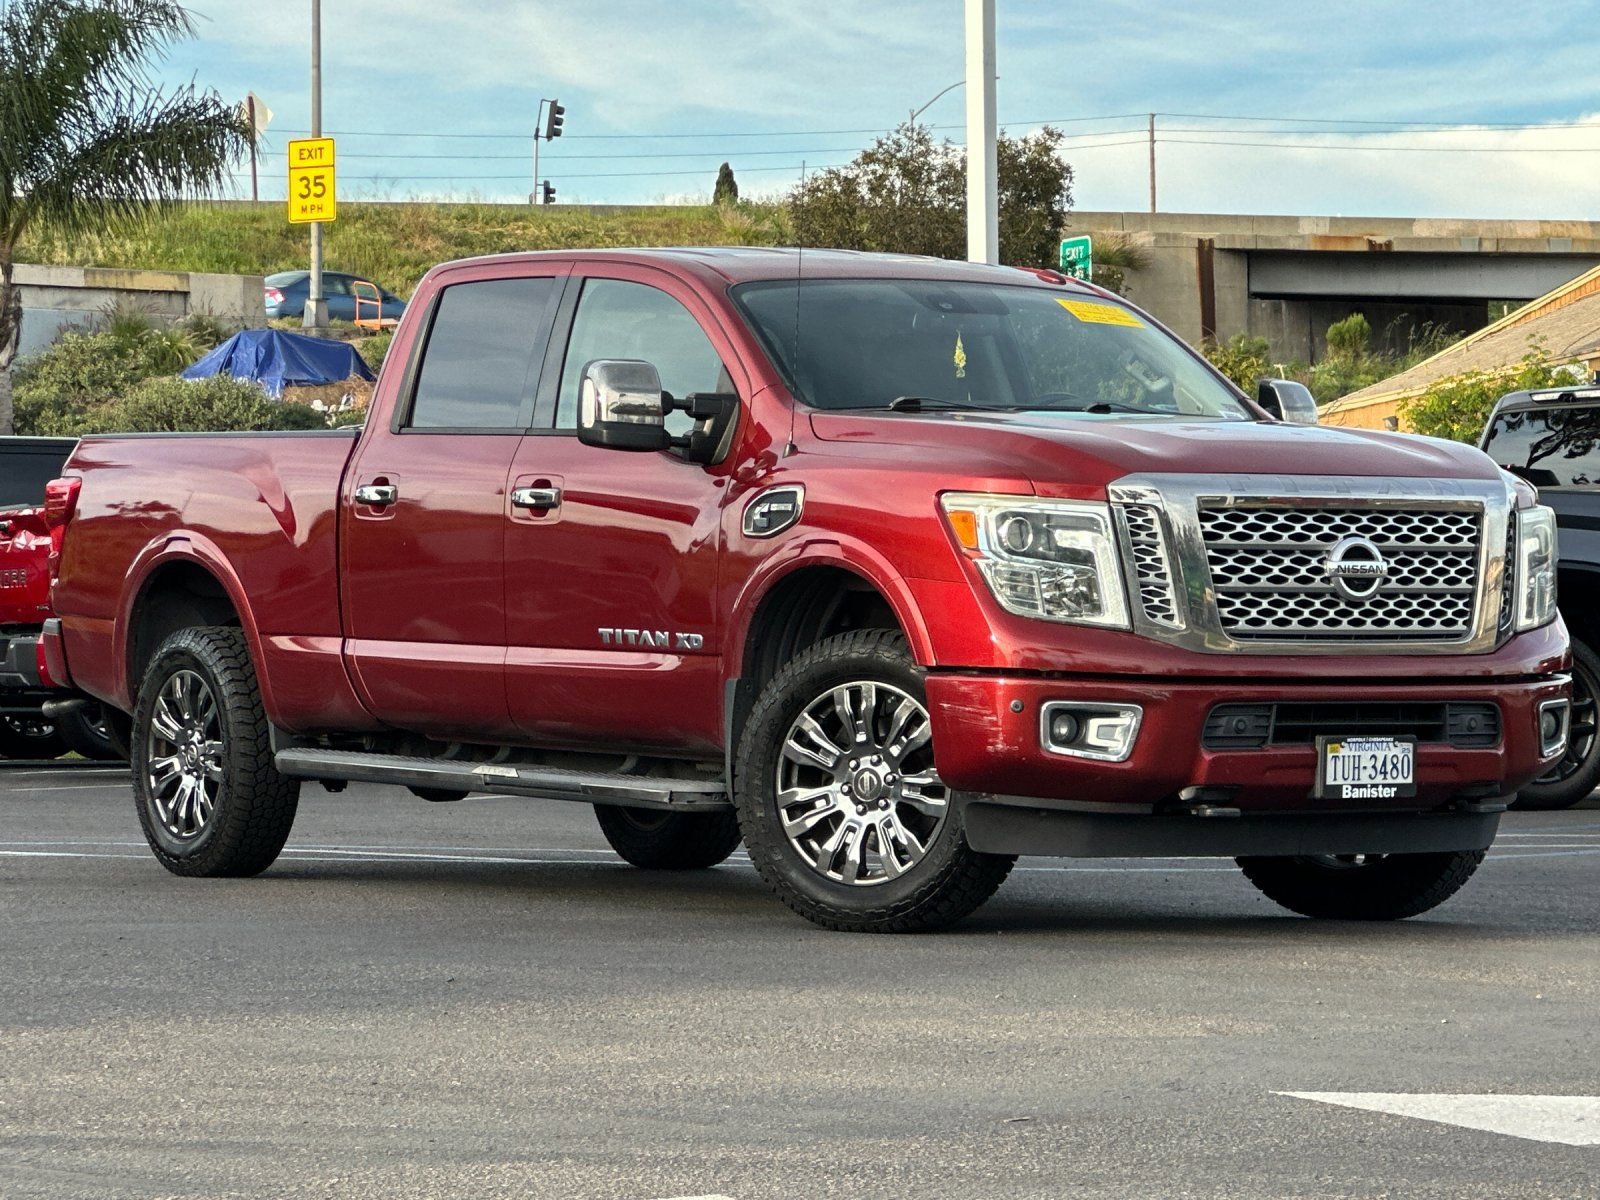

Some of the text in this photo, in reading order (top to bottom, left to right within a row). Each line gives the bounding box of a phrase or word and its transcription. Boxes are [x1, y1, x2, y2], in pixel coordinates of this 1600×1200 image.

[298, 147, 324, 160] EXIT
[298, 175, 326, 199] 35
[301, 204, 323, 214] MPH
[1065, 245, 1084, 260] EXIT
[1337, 564, 1384, 574] NISSAN
[598, 627, 704, 649] TITAN XD
[1348, 742, 1391, 752] VIRGINIA
[1331, 754, 1411, 781] TUH-3480
[1342, 783, 1397, 799] Banister
